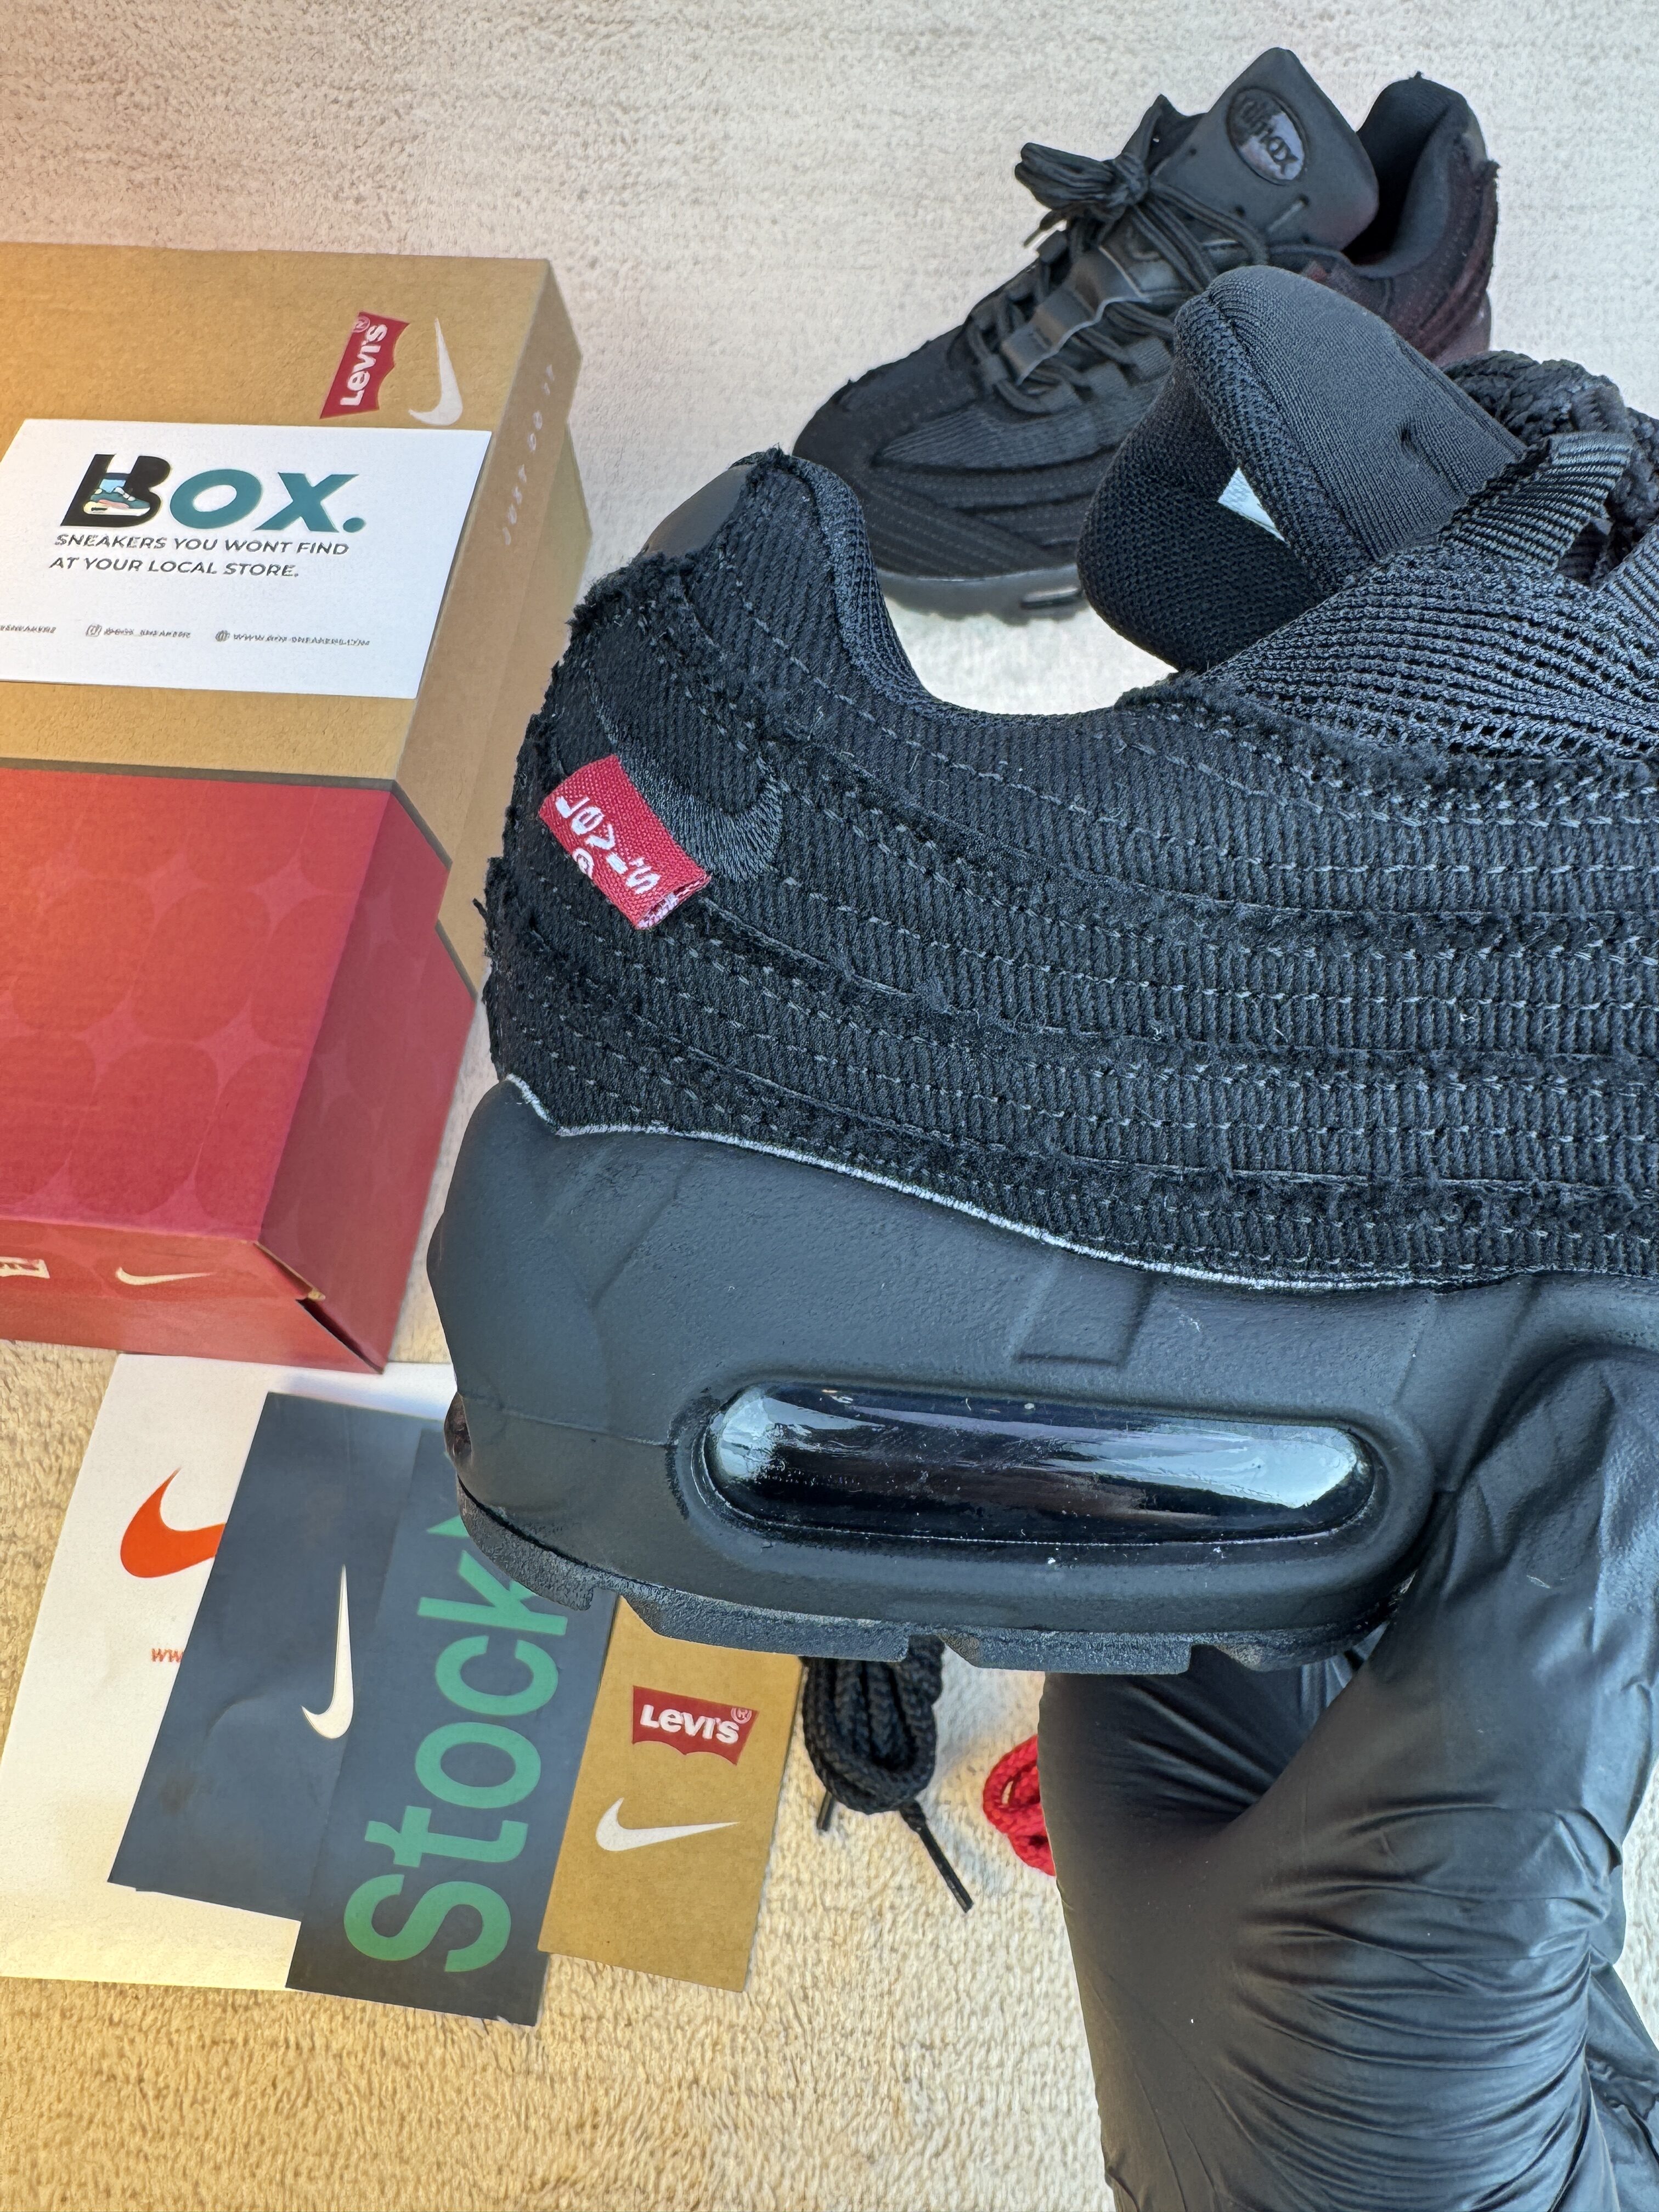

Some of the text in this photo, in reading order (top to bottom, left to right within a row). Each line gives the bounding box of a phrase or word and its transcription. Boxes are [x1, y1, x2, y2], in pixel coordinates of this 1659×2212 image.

[54, 534, 349, 556] SNEAKERS YOU WONT FIND
[49, 557, 299, 577] AT YOUR LOCAL STORE.
[343, 1515, 568, 1973] Stock
